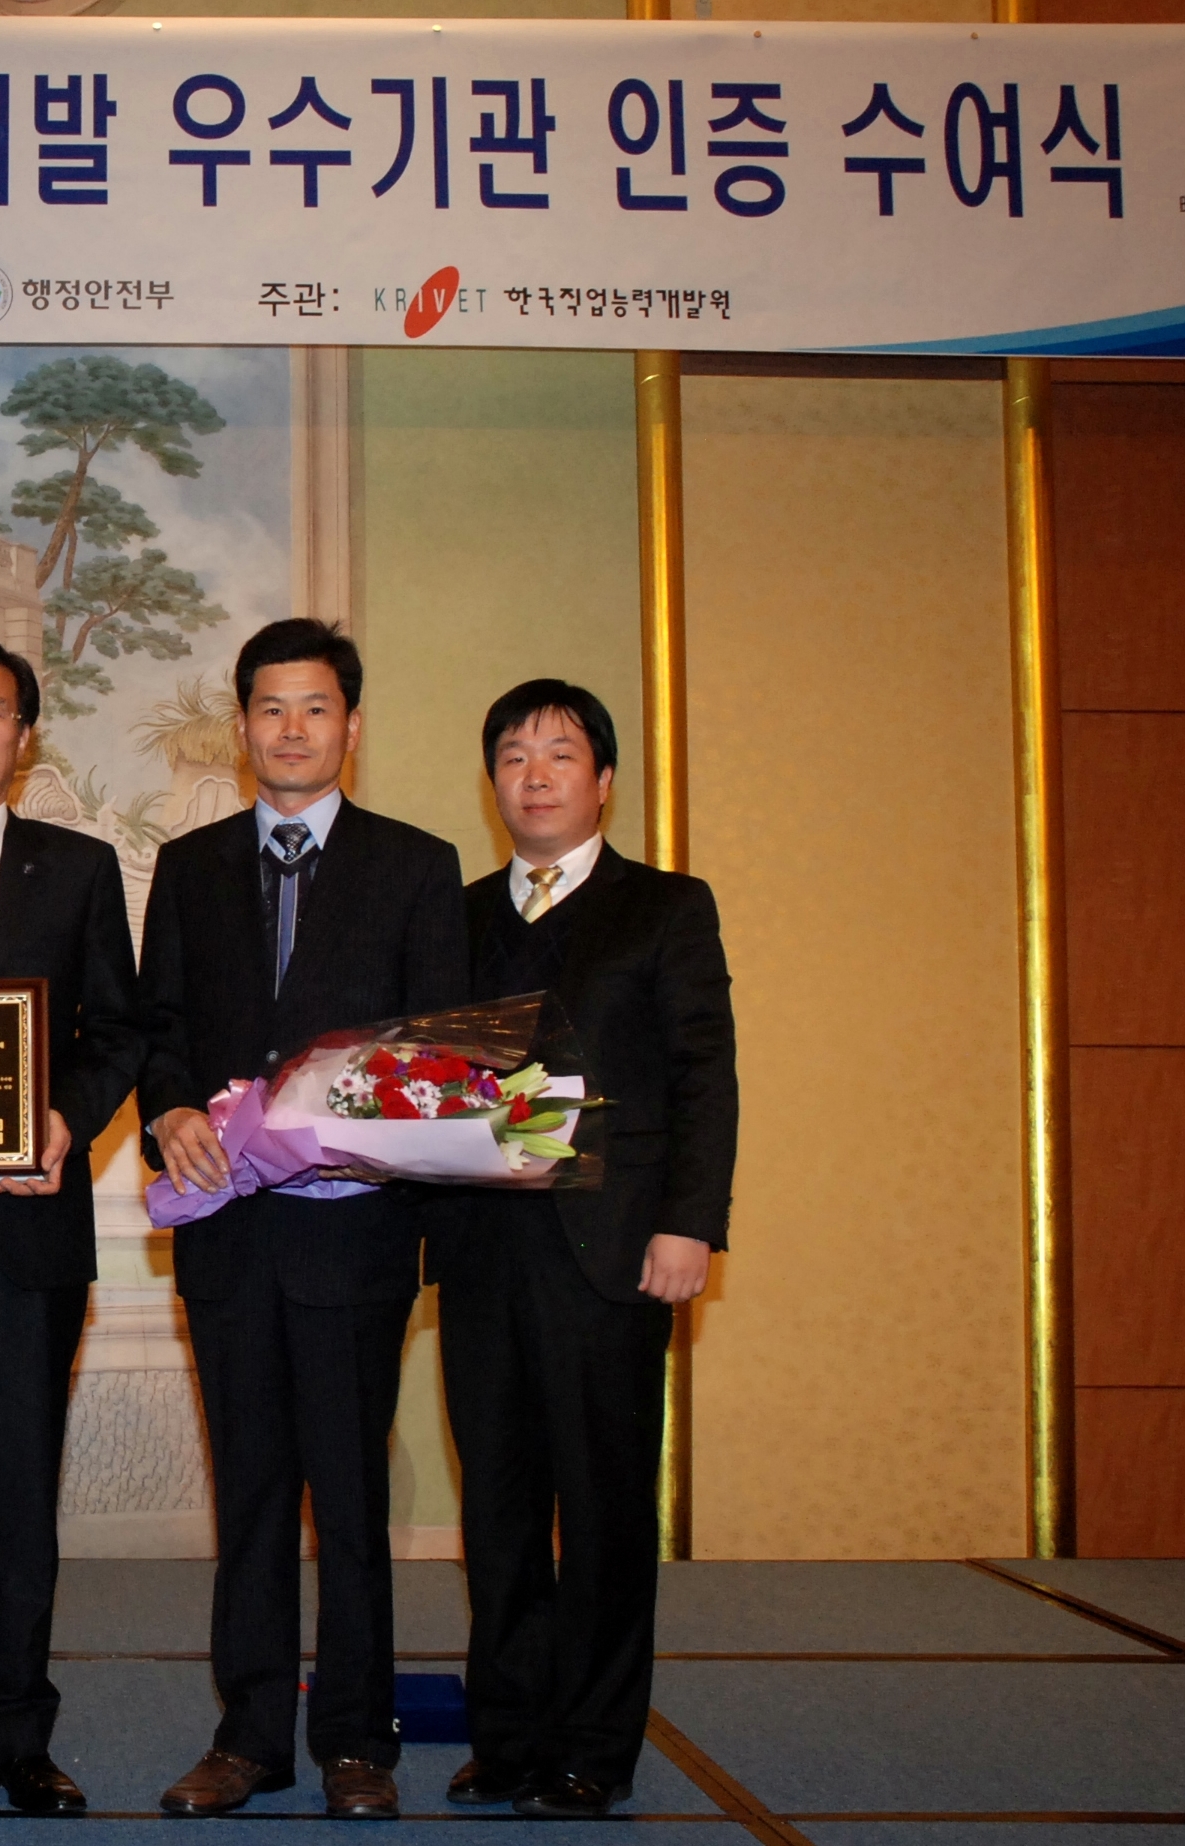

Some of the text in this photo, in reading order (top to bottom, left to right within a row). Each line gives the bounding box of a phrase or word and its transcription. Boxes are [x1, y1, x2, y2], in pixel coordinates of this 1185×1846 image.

[168, 73, 557, 210] 우수기관
[607, 78, 789, 218] 인증
[841, 81, 1124, 219] 수여식
[21, 278, 175, 311] 행정안전부
[374, 287, 487, 313] KRIVET
[503, 286, 732, 321] 한국직업능력개발원
